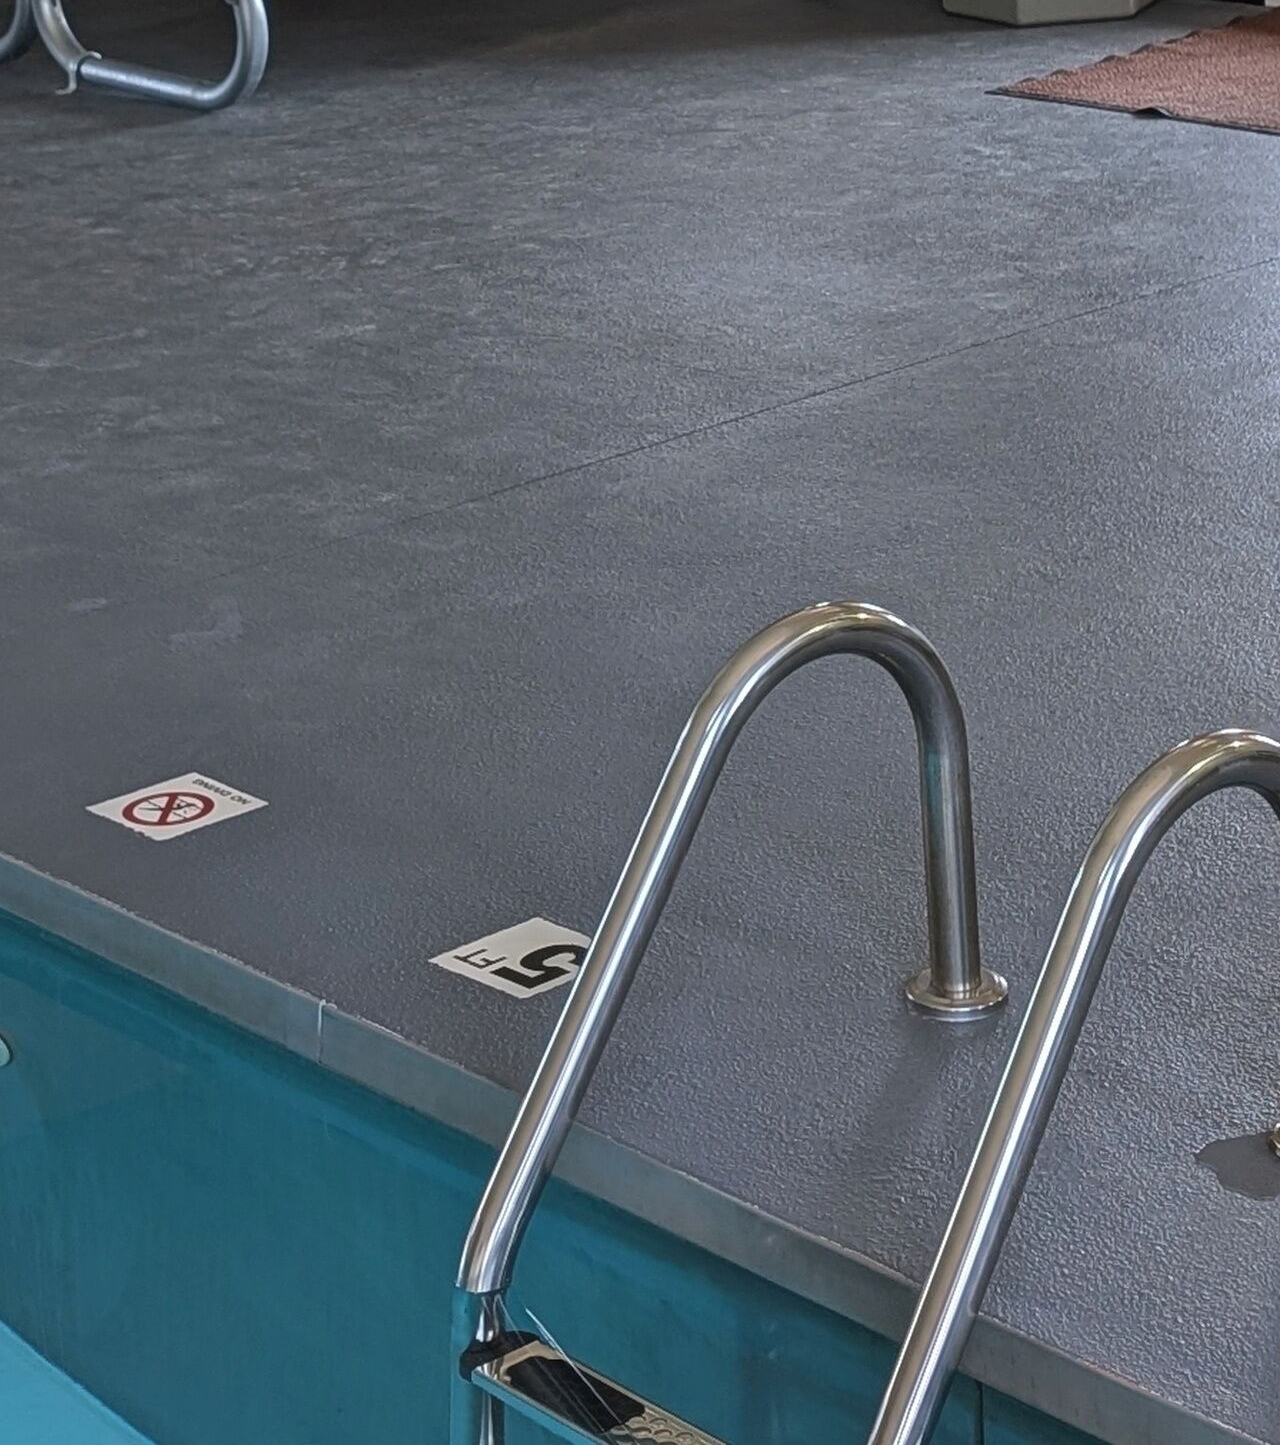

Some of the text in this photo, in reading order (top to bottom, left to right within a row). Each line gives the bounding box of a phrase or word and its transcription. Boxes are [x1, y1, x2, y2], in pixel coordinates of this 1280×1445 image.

[192, 779, 251, 805] NO DIVING
[453, 945, 589, 989] 5 FT
